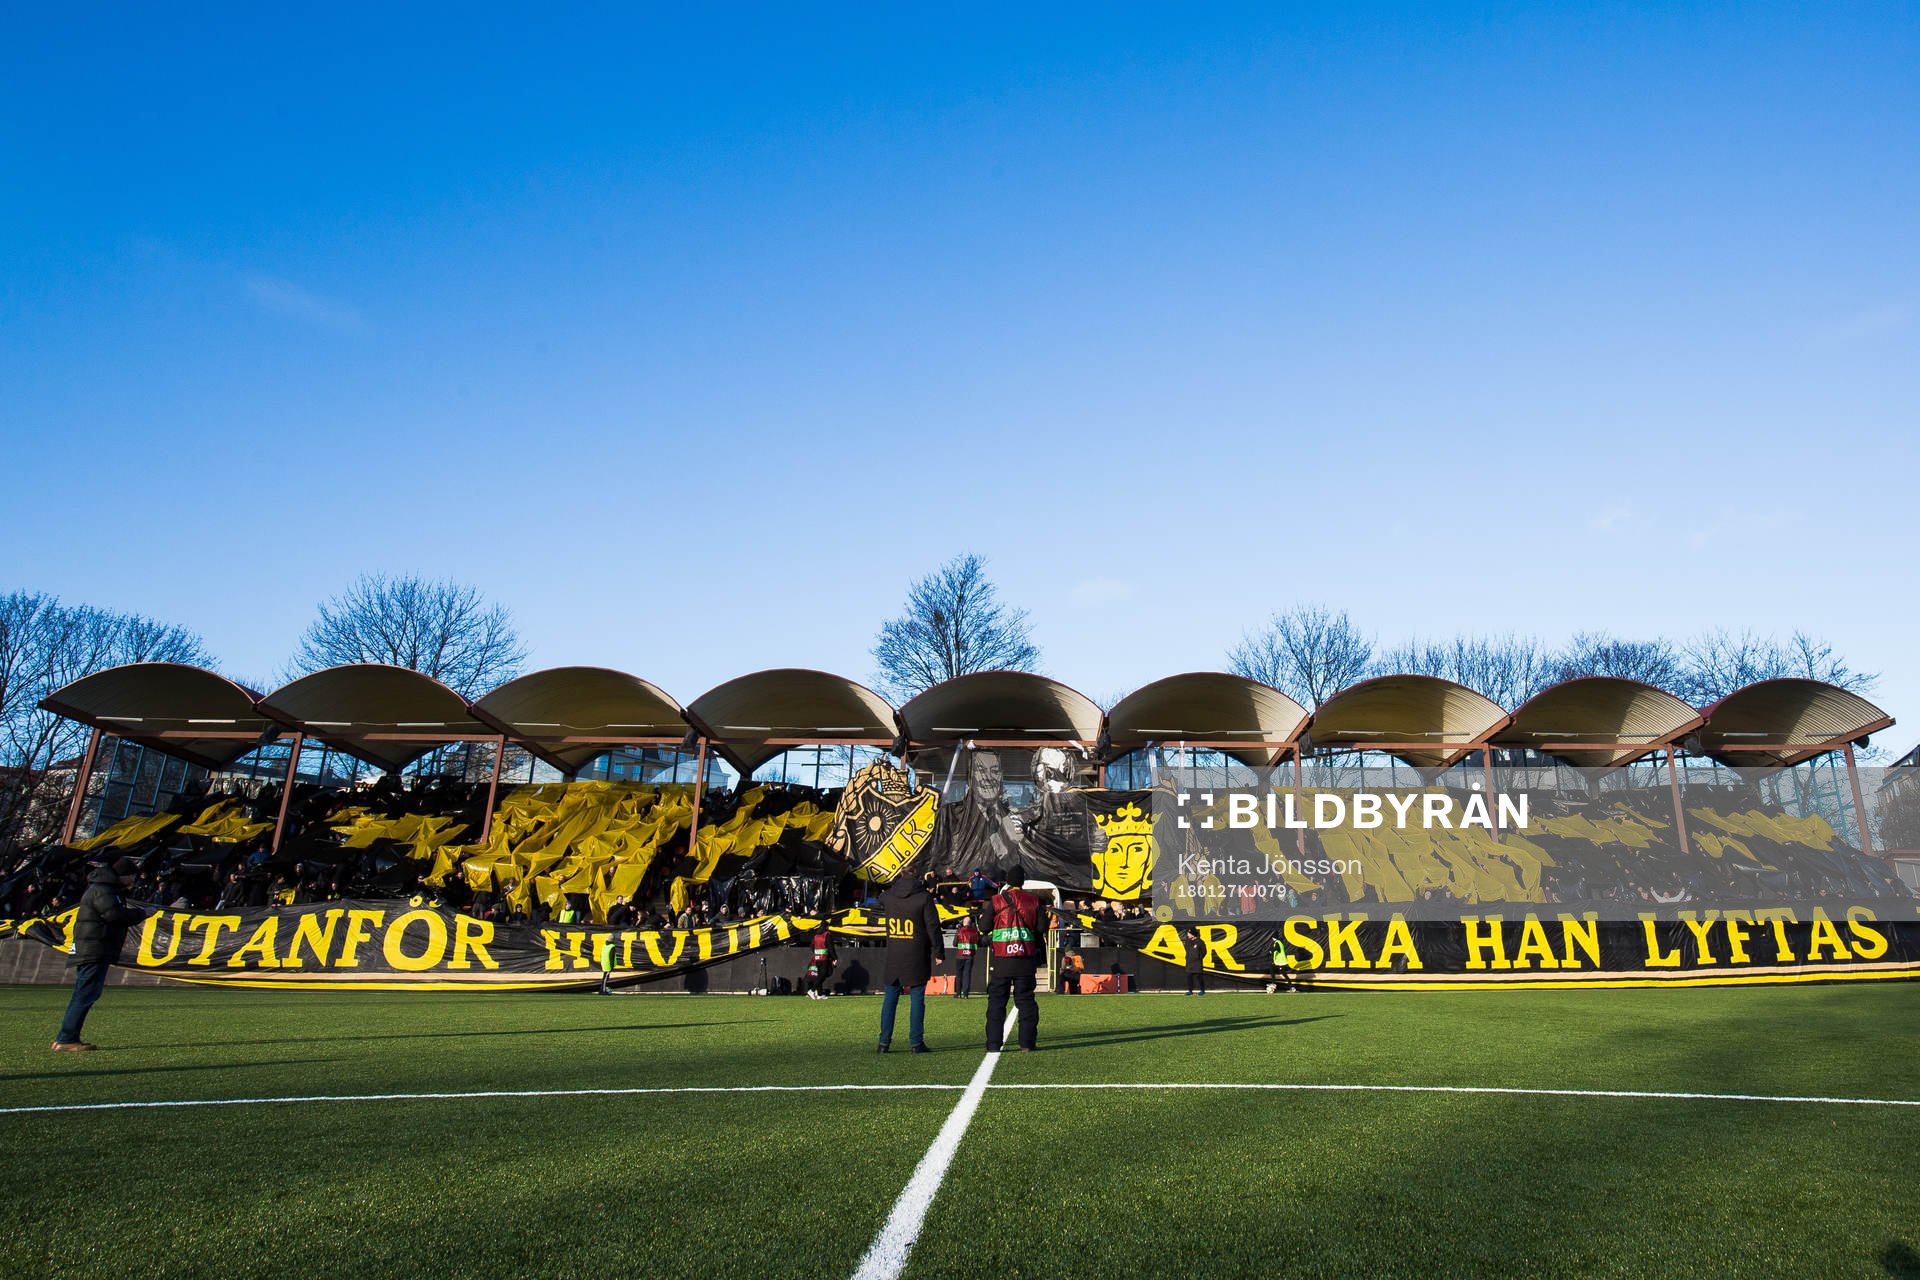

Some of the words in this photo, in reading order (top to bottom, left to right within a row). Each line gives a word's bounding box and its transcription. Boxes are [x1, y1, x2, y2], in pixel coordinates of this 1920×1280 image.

[137, 896, 499, 971] UTANFÖR
[1284, 912, 1423, 970] SKA
[1460, 911, 1600, 969] HAN
[1638, 905, 1888, 967] LYFTAS
[889, 918, 913, 935] SLO
